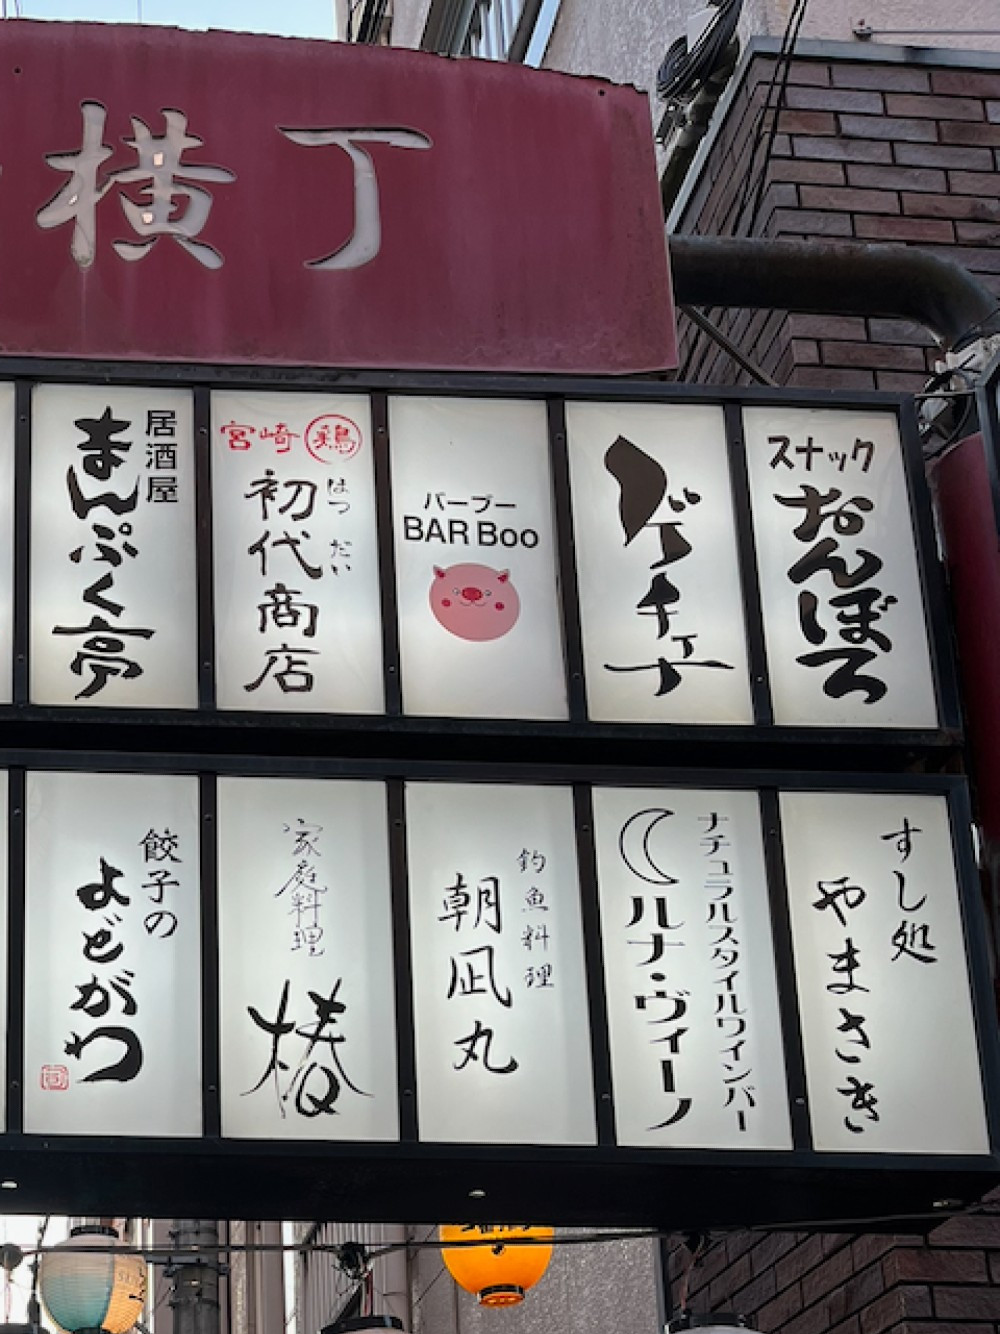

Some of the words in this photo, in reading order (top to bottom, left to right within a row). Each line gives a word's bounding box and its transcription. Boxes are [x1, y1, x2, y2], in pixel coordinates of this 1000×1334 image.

[145, 409, 179, 504] 居酒屋
[769, 435, 876, 471] スナック
[51, 406, 156, 700] まんぷく亭
[243, 468, 323, 693] 初代商店
[403, 514, 469, 545] BAR
[477, 520, 540, 548] Boo
[139, 828, 182, 939] 餃子の
[516, 848, 555, 990] 釣魚料理
[881, 818, 939, 964] すし処
[63, 857, 144, 1083] よどがわ
[437, 872, 519, 1074] 朝凪丸
[812, 875, 880, 1134] やまさき
